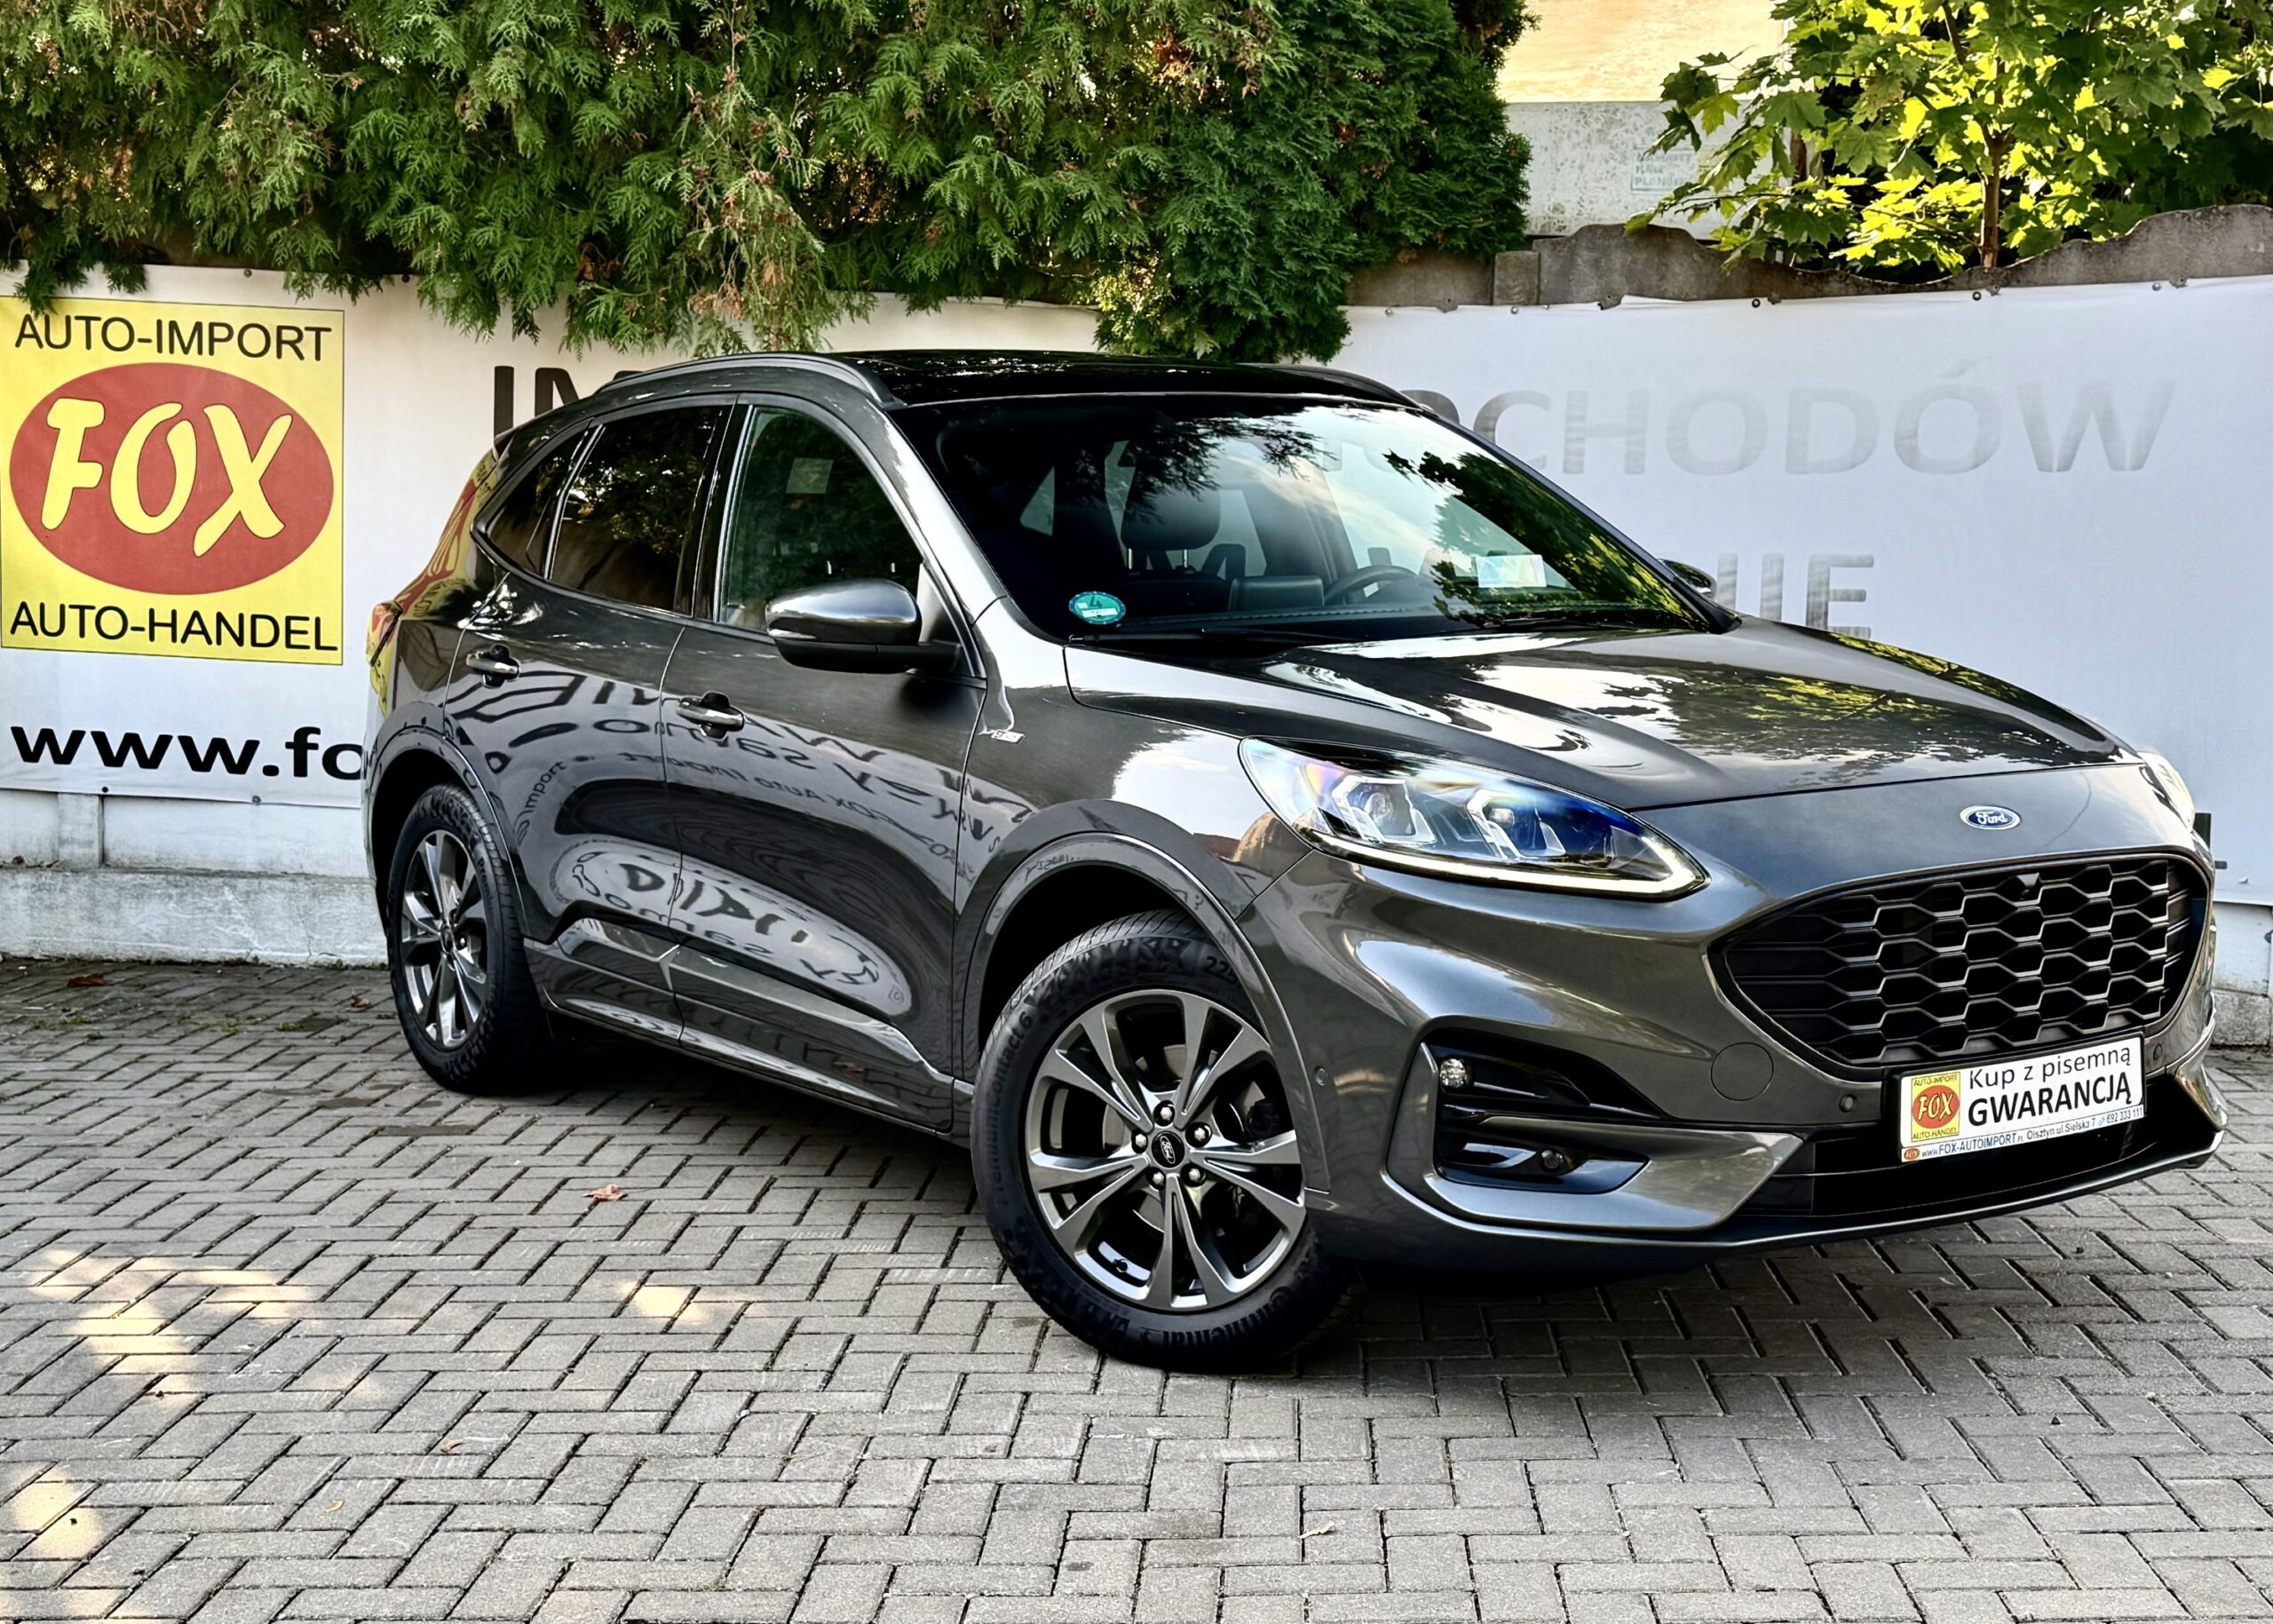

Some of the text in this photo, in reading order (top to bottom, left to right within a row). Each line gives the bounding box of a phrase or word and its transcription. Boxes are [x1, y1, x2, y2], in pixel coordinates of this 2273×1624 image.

[14, 314, 332, 361] AUTO-IMPORT
[1400, 360, 2174, 476] CHODÓW
[41, 397, 294, 558] FOX
[10, 601, 338, 652] AUTO-HANDEL
[11, 725, 367, 780] www.fo
[1976, 811, 2008, 825] Ford
[1019, 1011, 1033, 1029] 6
[1913, 1074, 1958, 1086] AUTO-IMPORT
[1969, 1047, 2131, 1089] Kup z pisemną
[1918, 1092, 1953, 1121] FOX
[1968, 1072, 2132, 1127] GWARANCJĄ
